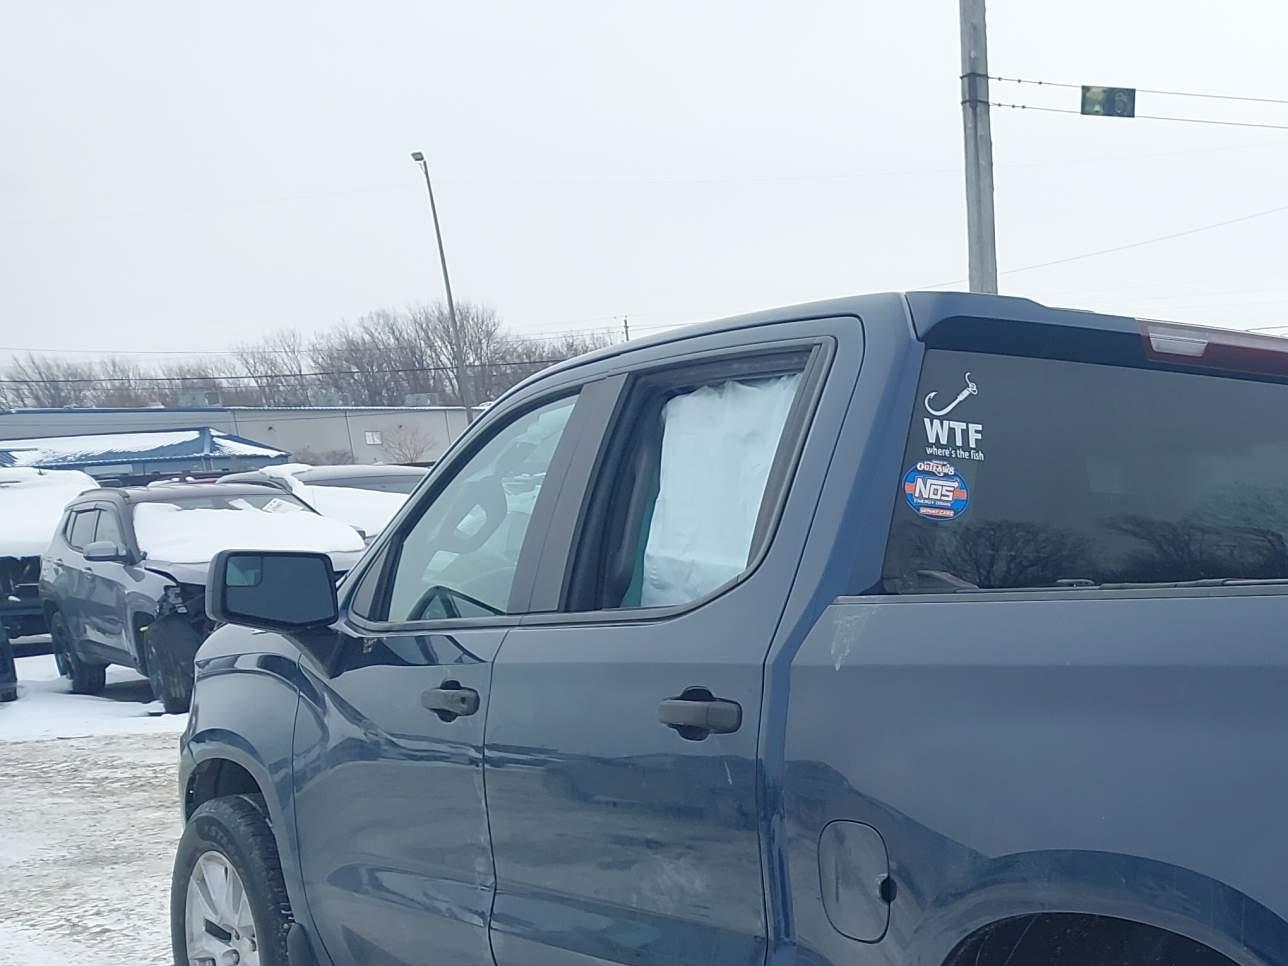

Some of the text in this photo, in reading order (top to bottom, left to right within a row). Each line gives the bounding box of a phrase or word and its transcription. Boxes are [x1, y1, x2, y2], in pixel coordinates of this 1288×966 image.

[924, 418, 982, 448] WTF
[926, 445, 984, 461] where's the fish
[915, 478, 959, 500] NOS
